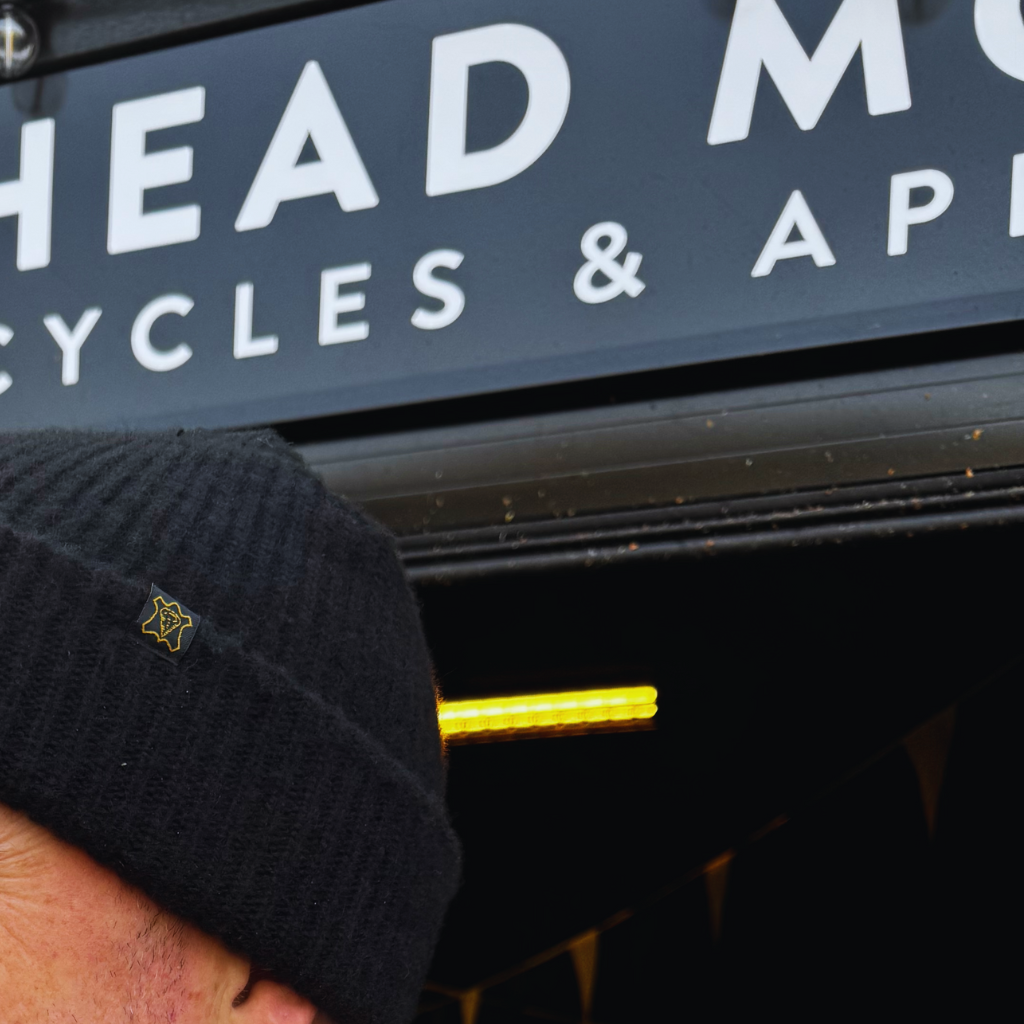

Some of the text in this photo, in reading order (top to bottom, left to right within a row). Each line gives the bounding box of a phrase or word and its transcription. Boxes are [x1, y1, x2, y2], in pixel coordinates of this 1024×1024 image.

[706, 0, 1024, 146] M
[573, 221, 646, 304] &
[750, 152, 1024, 278] AP
